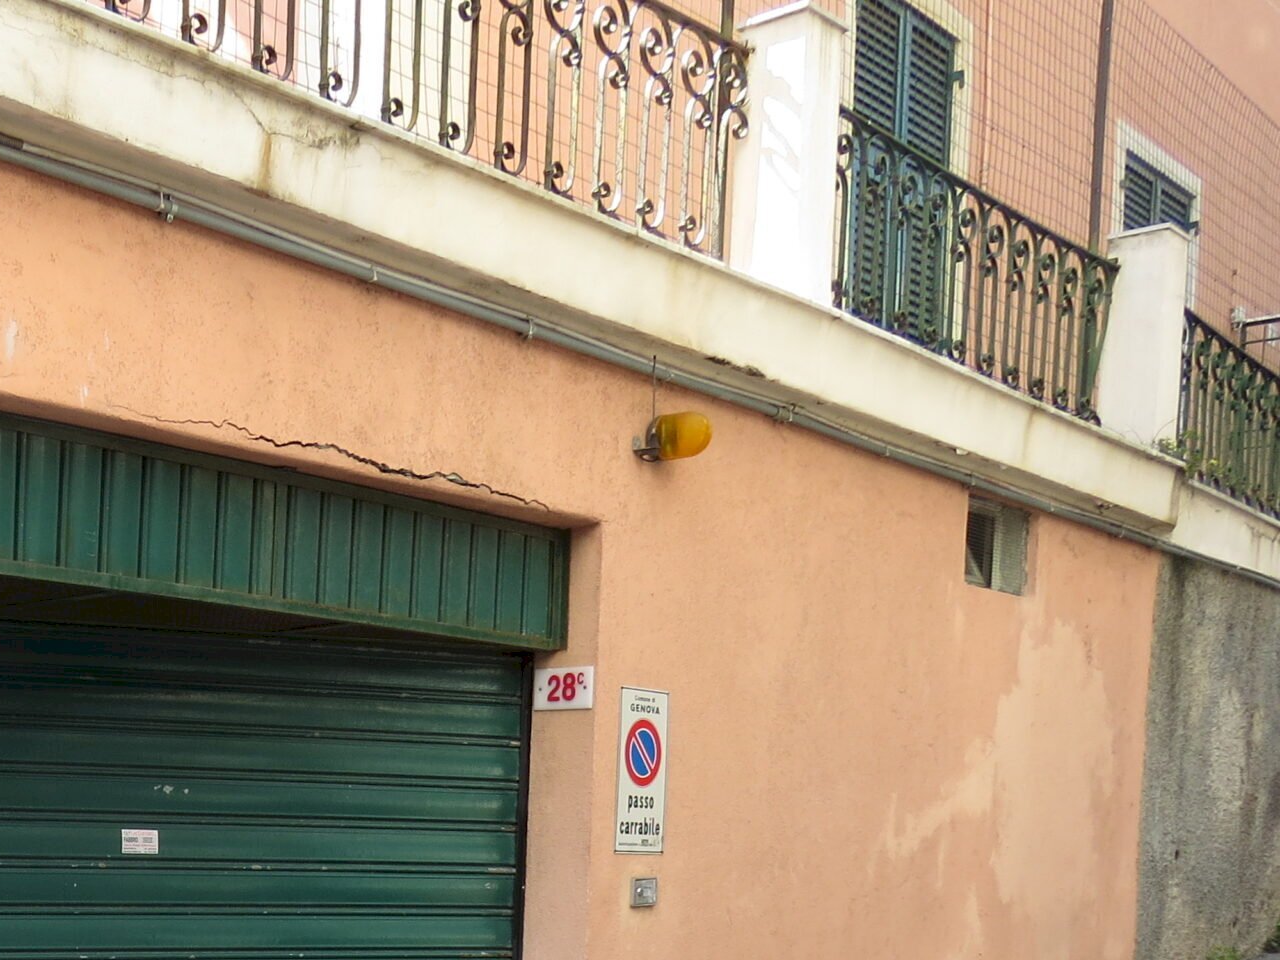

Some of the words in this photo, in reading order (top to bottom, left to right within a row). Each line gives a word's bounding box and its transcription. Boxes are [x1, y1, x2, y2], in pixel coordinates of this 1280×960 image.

[630, 703, 660, 714] GENOVA
[627, 795, 654, 813] passo
[619, 817, 660, 836] carrabile
